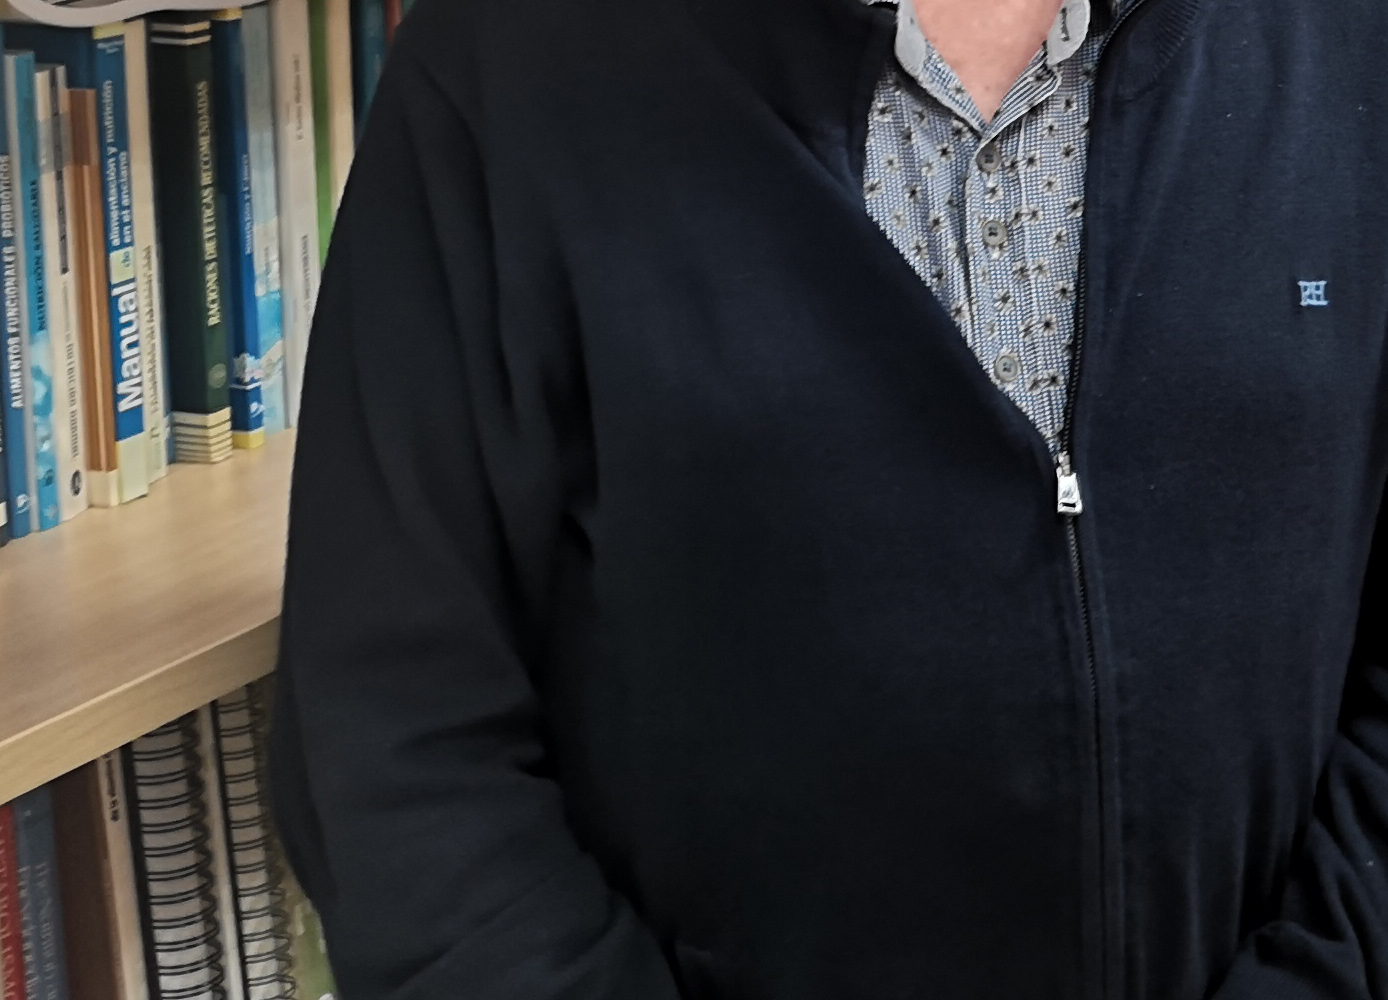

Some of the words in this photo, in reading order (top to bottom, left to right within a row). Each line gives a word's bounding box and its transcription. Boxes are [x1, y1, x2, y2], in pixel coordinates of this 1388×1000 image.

[102, 80, 115, 142] nutrición
[195, 81, 212, 185] RECOMENDADAS
[105, 157, 120, 246] alimentación
[116, 151, 131, 206] anciano
[120, 209, 130, 222] el
[122, 225, 131, 243] en
[3, 245, 21, 332] FUNCIONALES
[204, 261, 221, 326] RACIONES
[8, 336, 26, 407] ALIMENTOS
[111, 281, 144, 413] Manual
